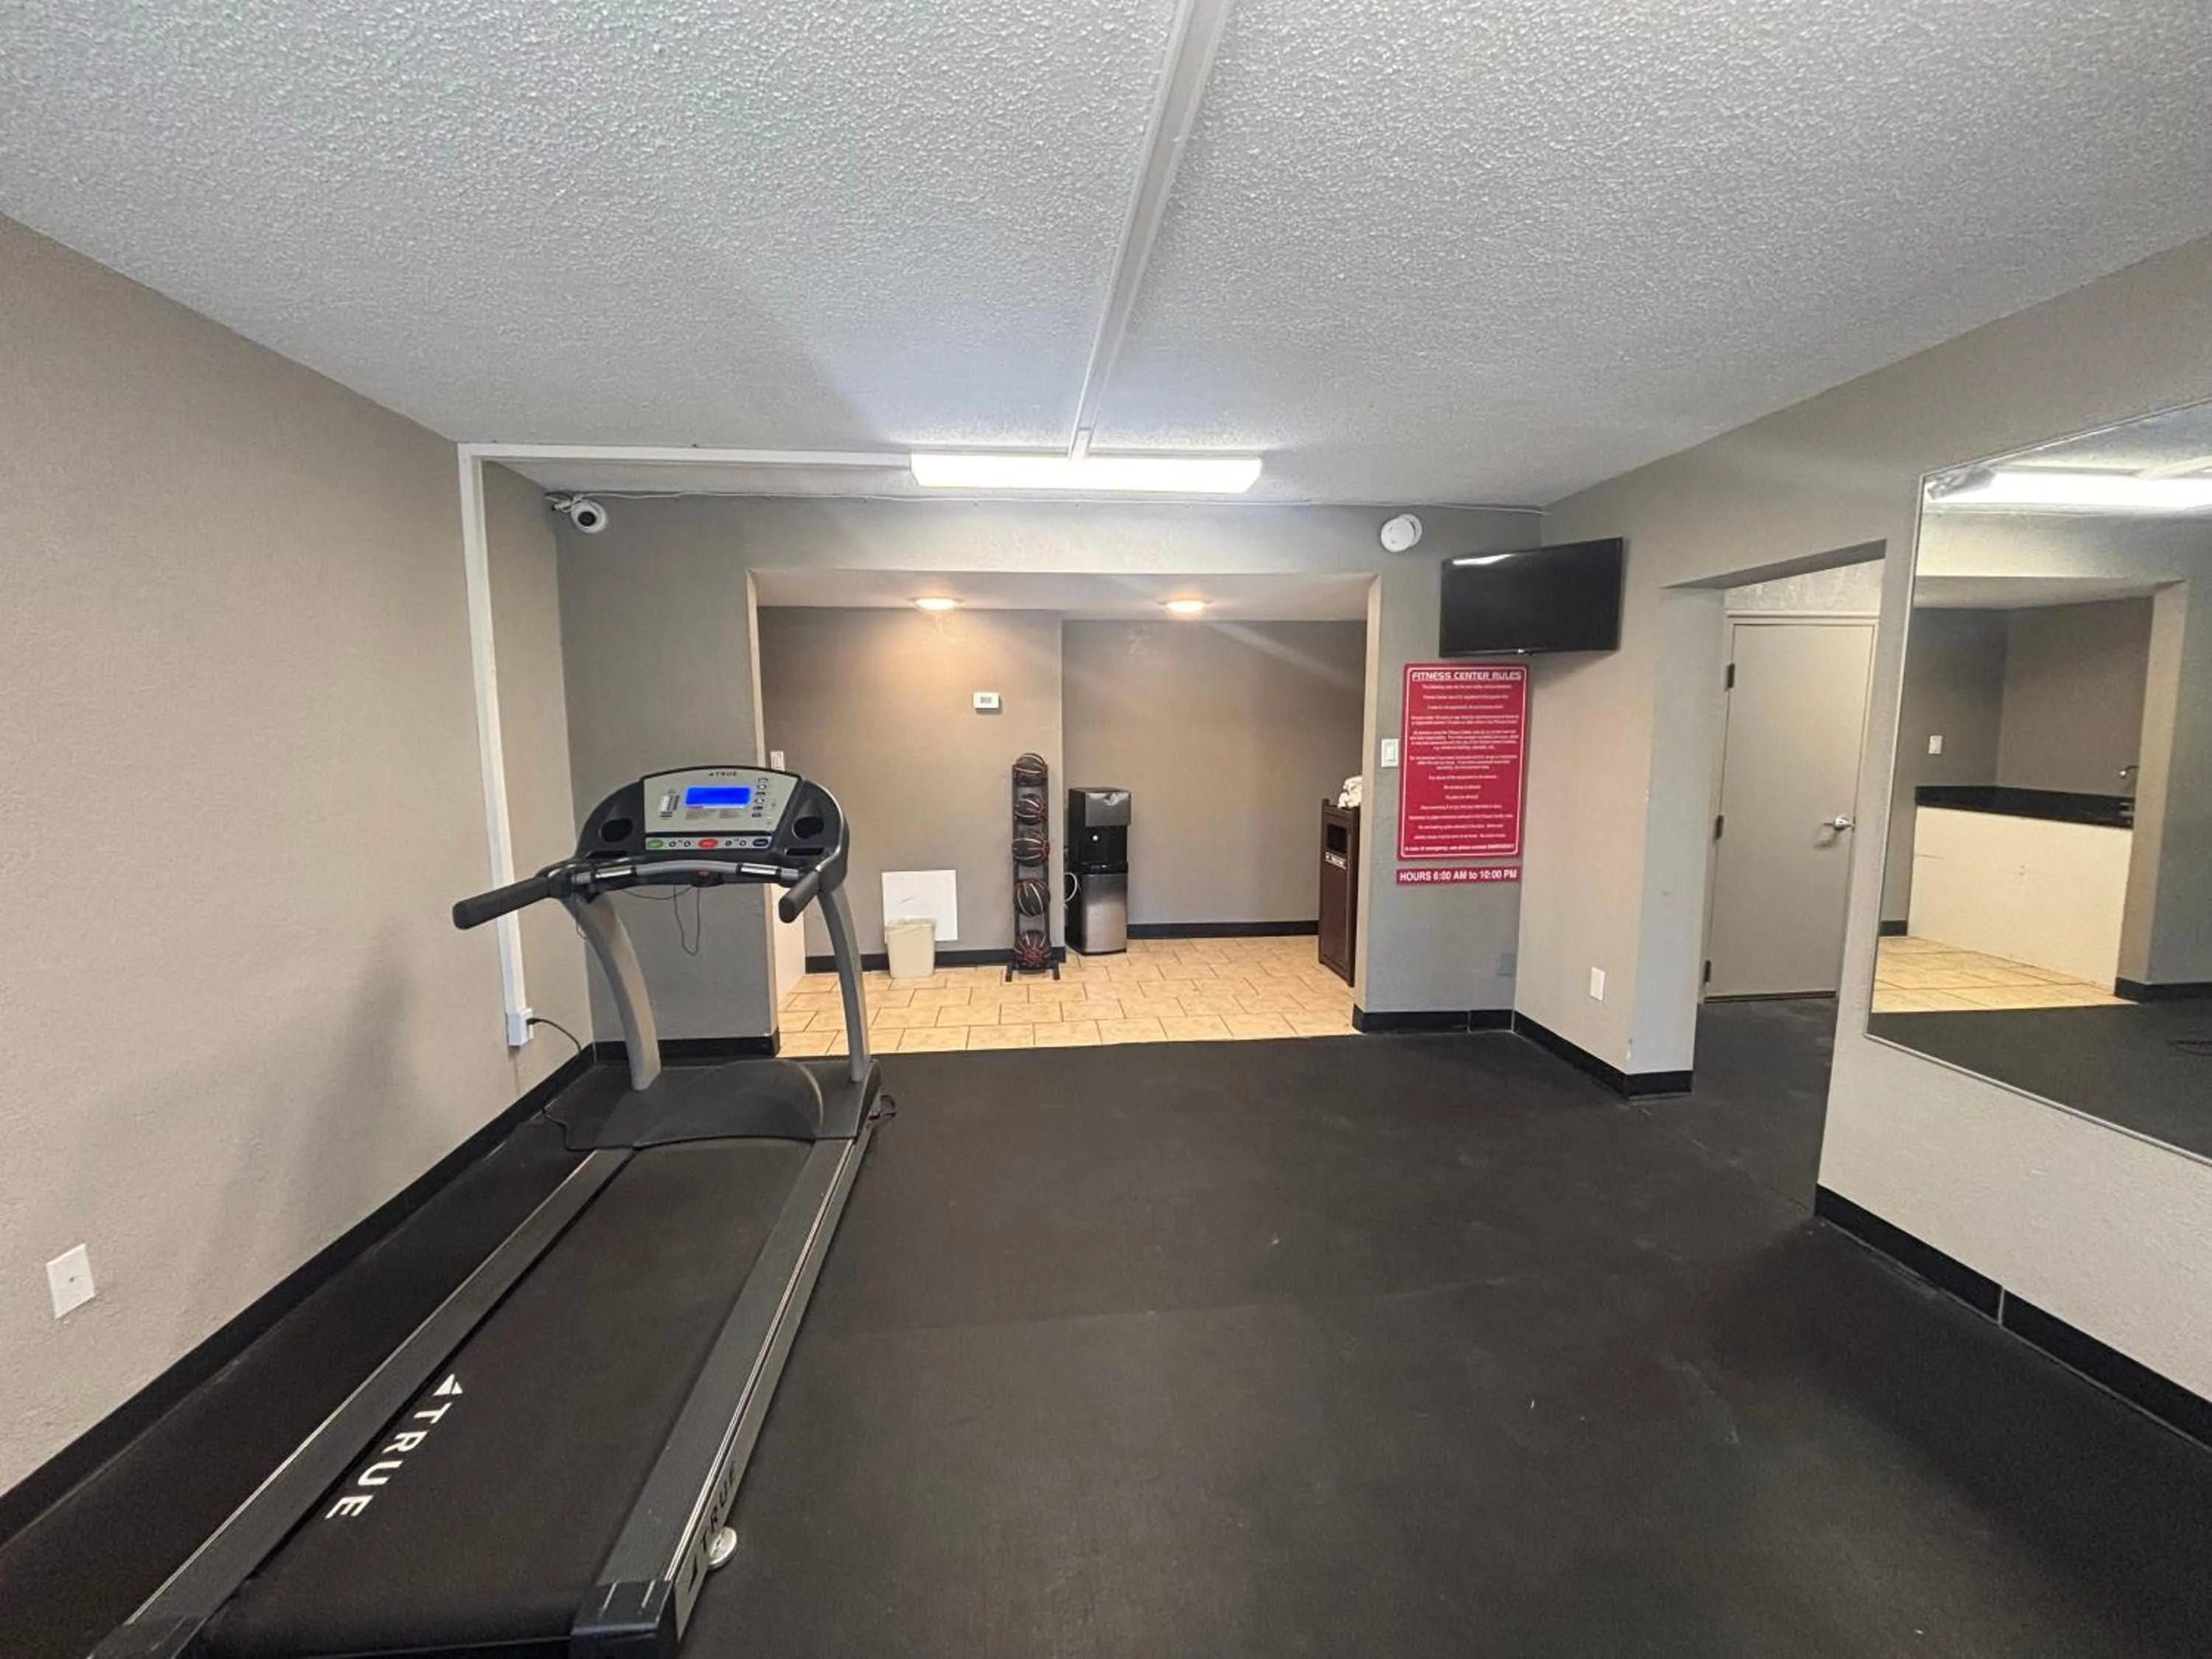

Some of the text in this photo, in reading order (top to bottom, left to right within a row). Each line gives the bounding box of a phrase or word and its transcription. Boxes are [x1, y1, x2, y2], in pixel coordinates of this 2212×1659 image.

[1412, 672, 1522, 681] FITNESS CENTER RULES
[1399, 872, 1431, 881] HOURS
[1453, 871, 1467, 880] AM
[1469, 871, 1478, 879] to
[1480, 870, 1501, 879] 10:00
[1503, 869, 1517, 878] PM
[325, 1402, 453, 1520] TRUE
[700, 1461, 736, 1553] TRUE
